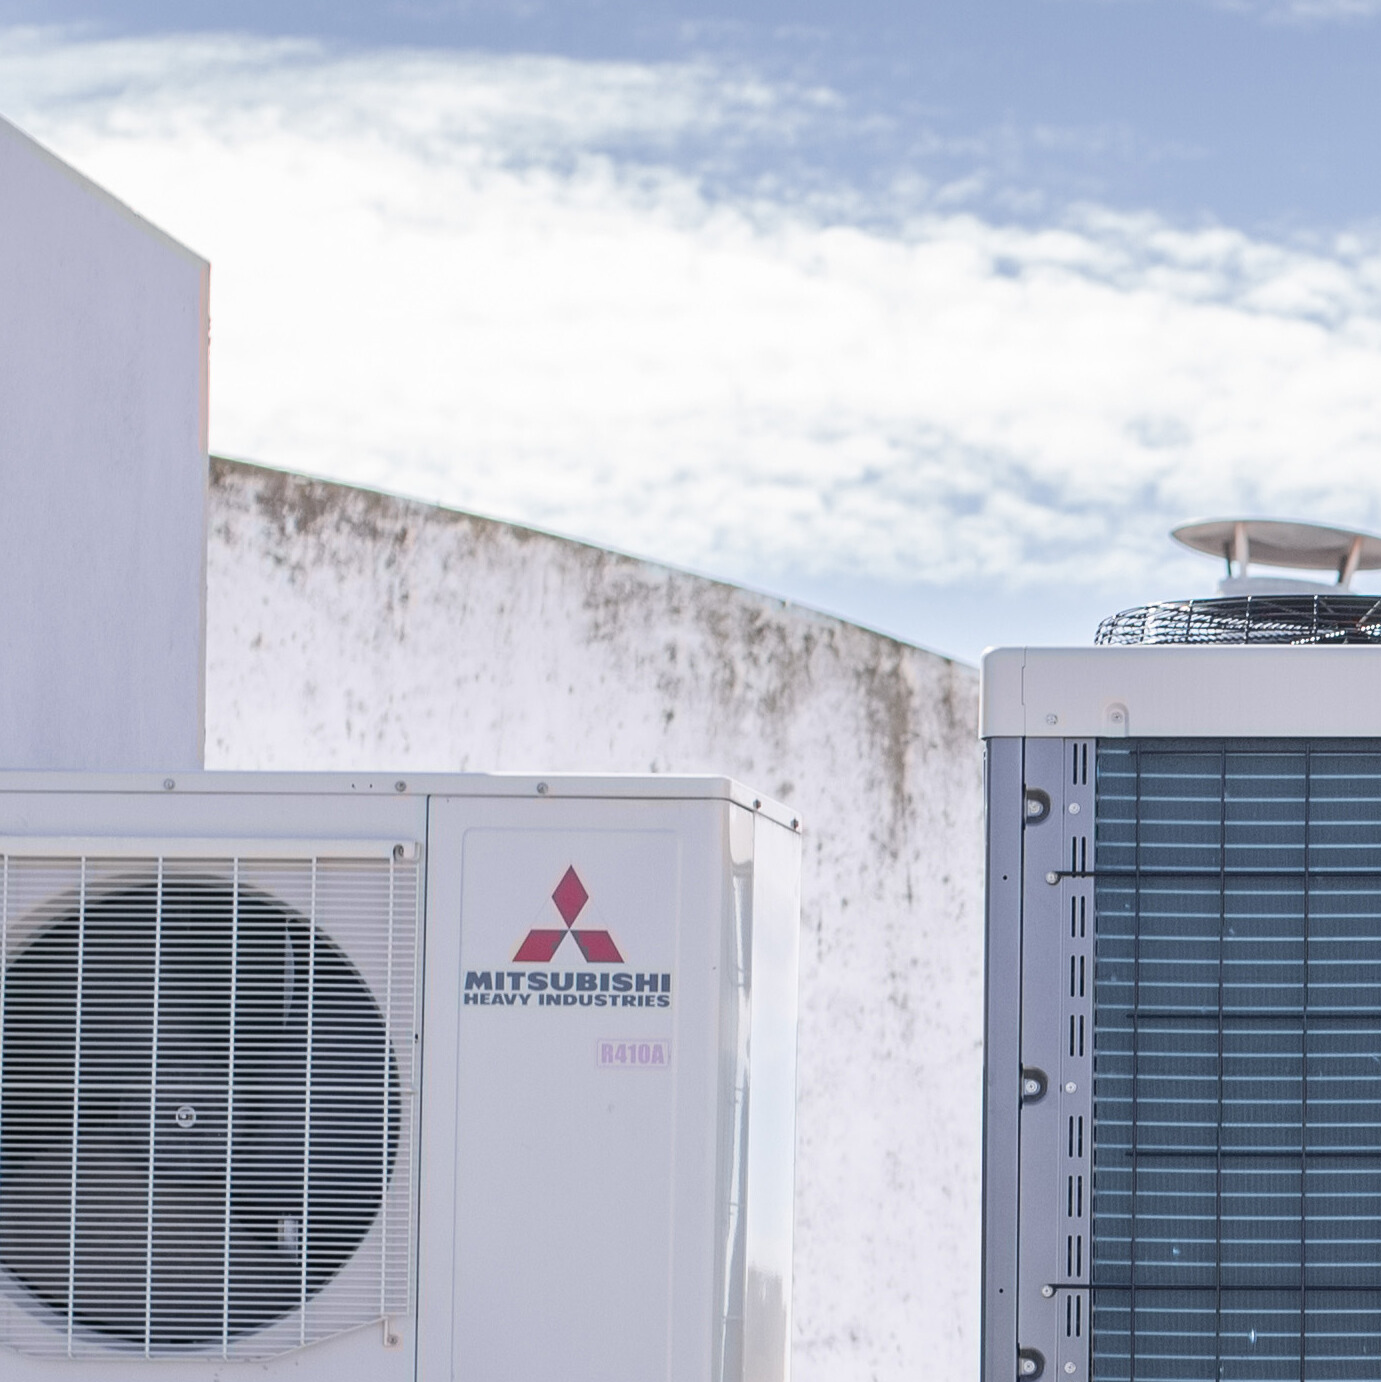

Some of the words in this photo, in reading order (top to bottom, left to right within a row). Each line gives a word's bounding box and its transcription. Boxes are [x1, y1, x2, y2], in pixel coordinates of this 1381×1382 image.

[464, 971, 671, 992] MITSUBISHI
[464, 992, 531, 1006] HEAVY
[538, 994, 671, 1008] INDUSTRIES
[601, 1043, 665, 1064] R410A
